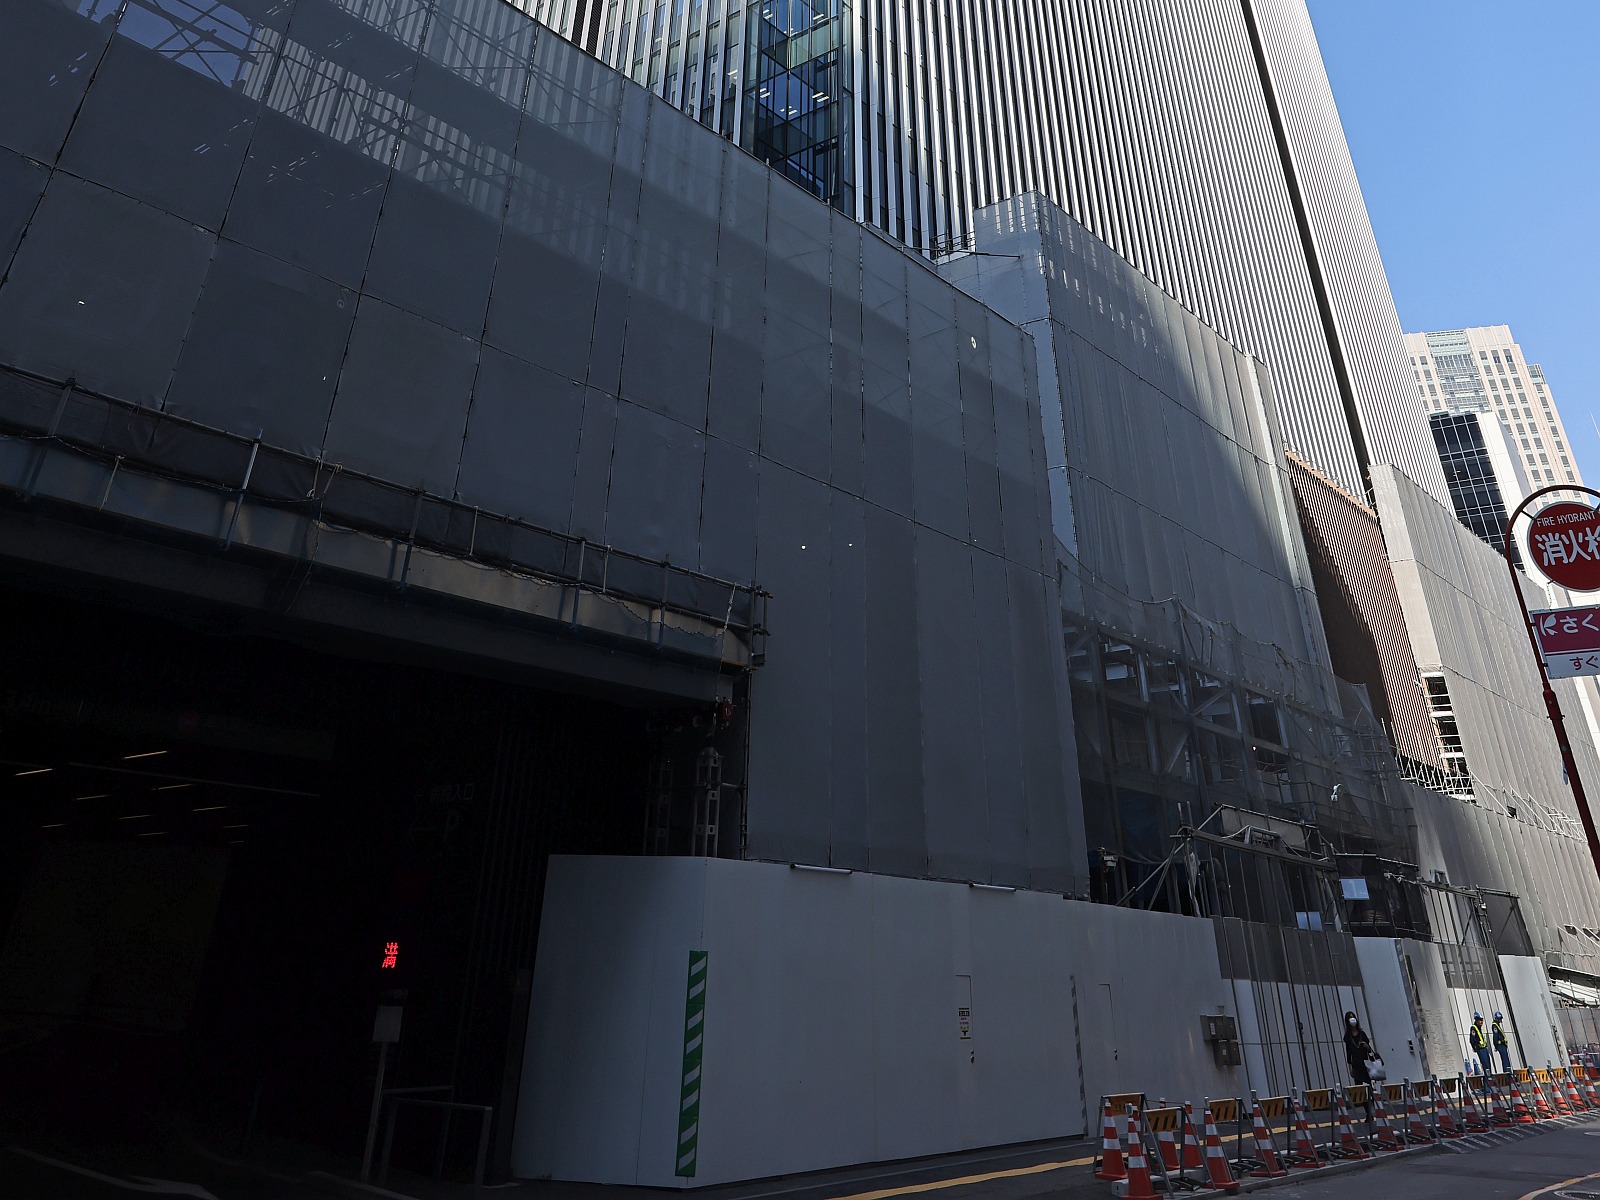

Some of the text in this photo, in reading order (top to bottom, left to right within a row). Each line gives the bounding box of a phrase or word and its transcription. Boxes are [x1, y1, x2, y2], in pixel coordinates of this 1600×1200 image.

[1537, 511, 1596, 527] FIRE HYDRANT
[1569, 655, 1599, 671] すぐ
